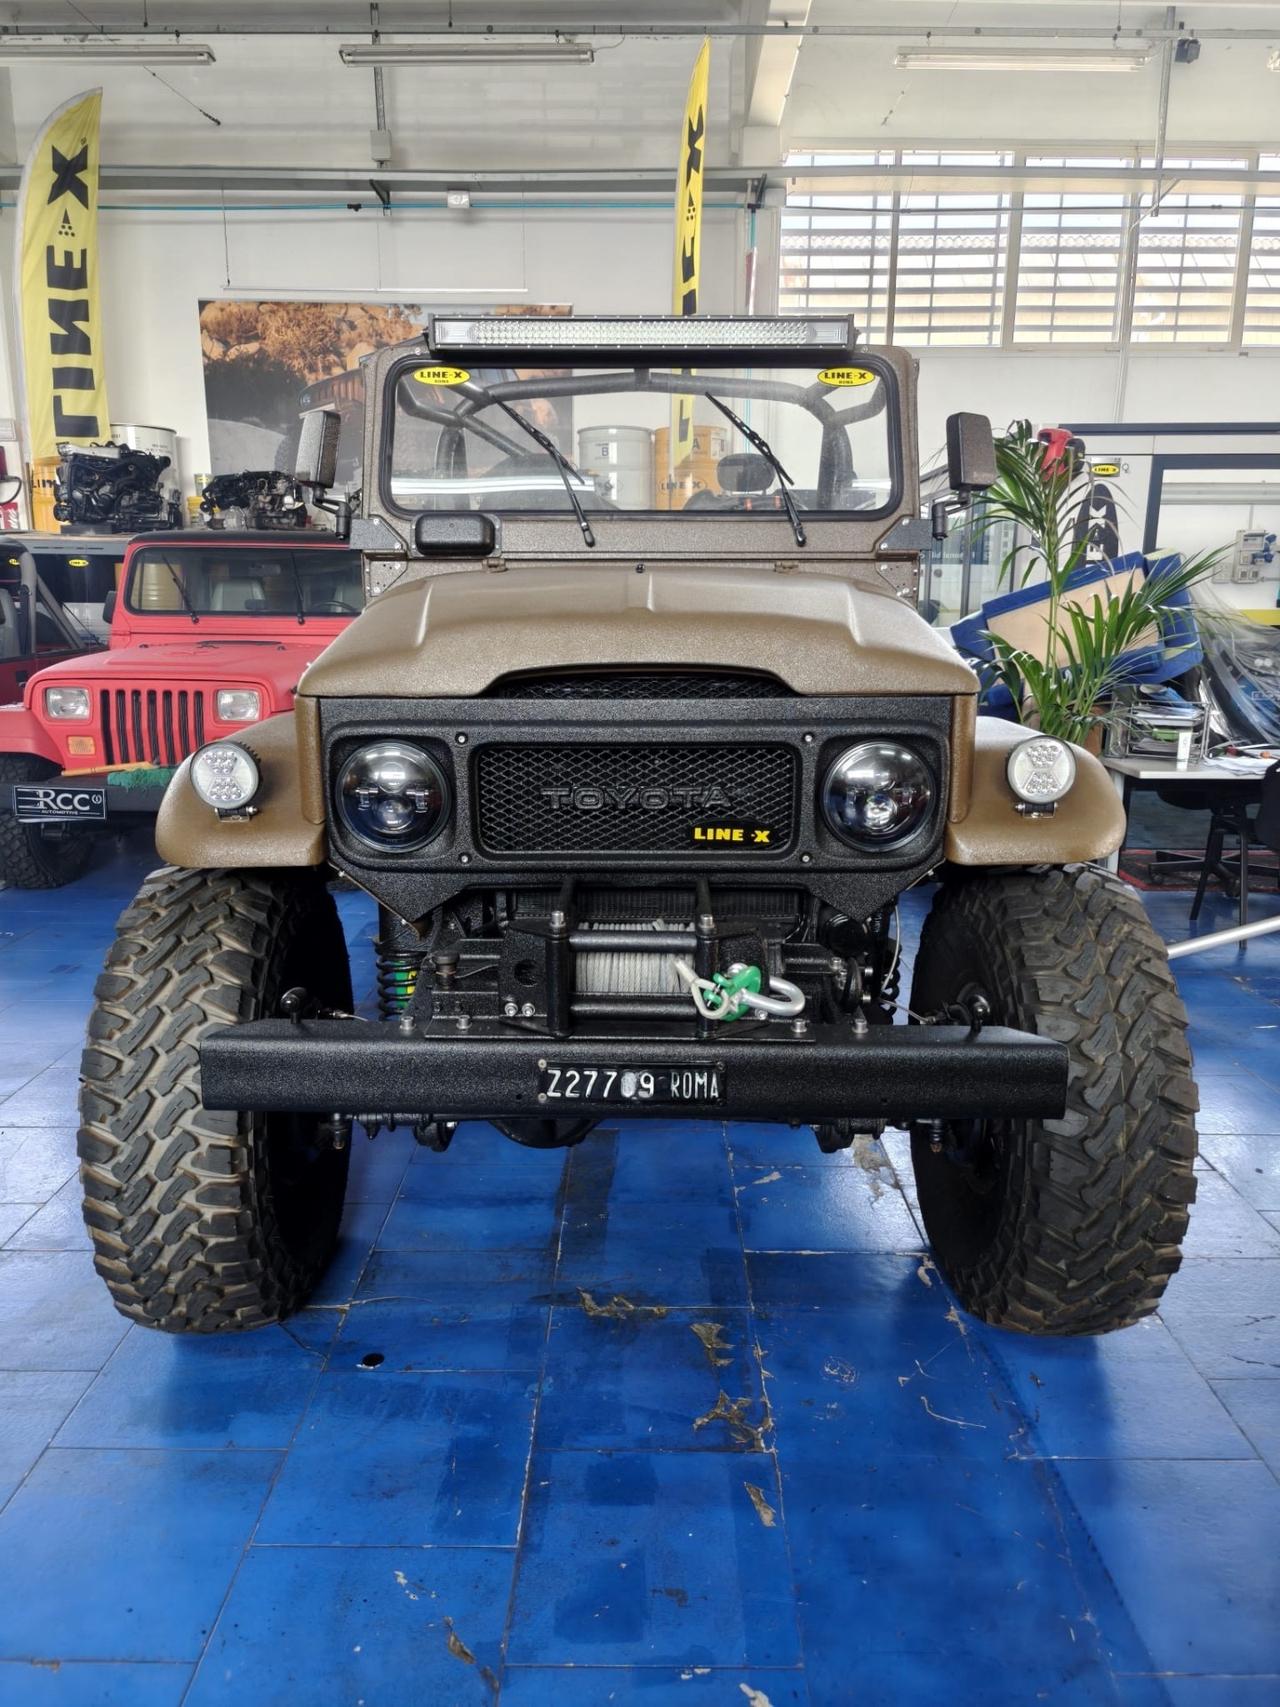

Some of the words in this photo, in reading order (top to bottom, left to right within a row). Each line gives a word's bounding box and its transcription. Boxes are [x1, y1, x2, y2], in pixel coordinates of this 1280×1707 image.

[37, 789, 91, 811] RCC
[540, 786, 732, 810] TOYOTA
[671, 1072, 719, 1099] ROMA
